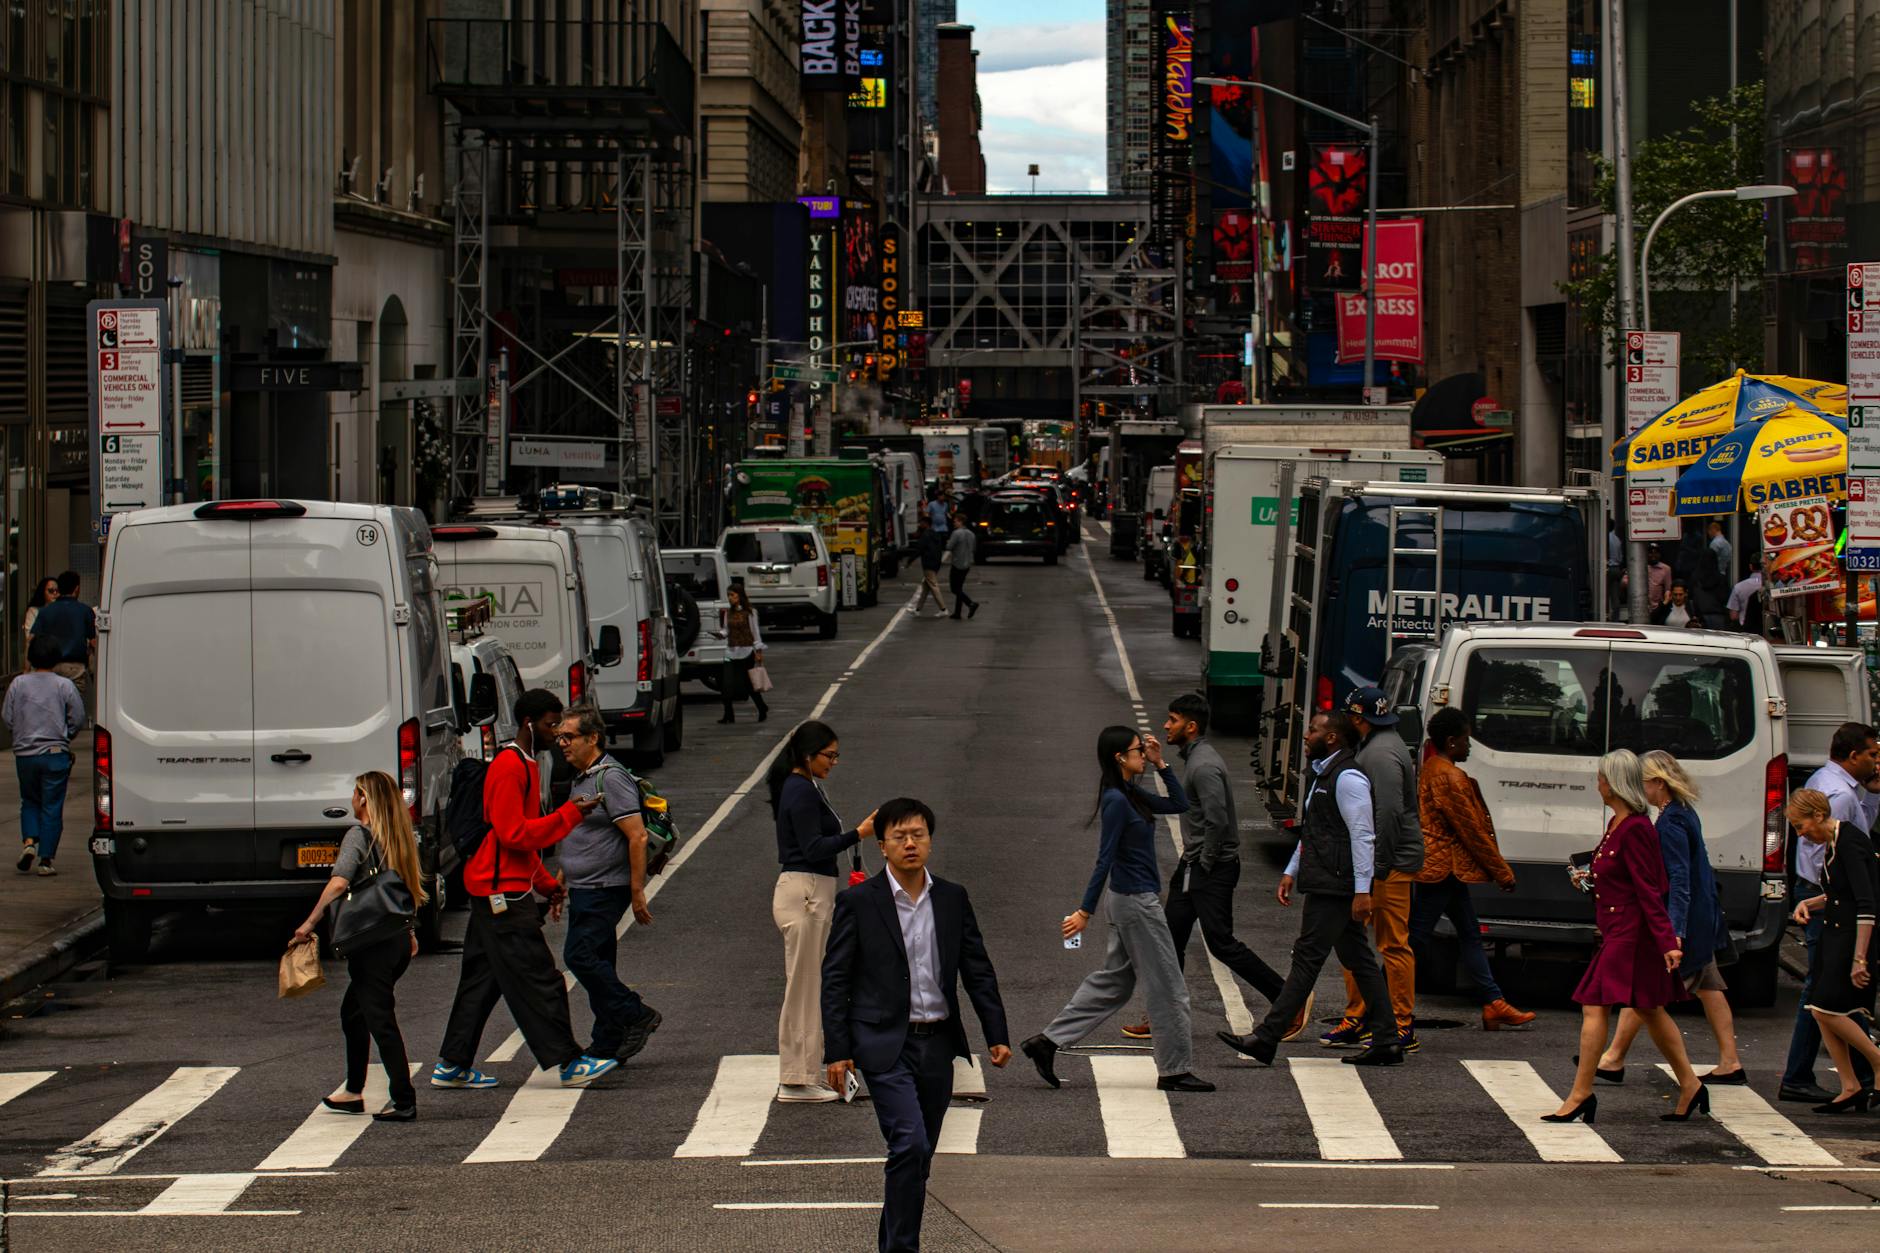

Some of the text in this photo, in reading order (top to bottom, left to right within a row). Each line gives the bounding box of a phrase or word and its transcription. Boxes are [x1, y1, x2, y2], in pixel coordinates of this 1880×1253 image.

[801, 0, 838, 74] BACK
[844, 0, 860, 75] BACK
[1166, 16, 1193, 140] Aladdin
[809, 235, 823, 309] YARD
[1345, 298, 1416, 316] EXRESS
[1852, 314, 1860, 331] 3
[105, 353, 115, 370] 3
[104, 375, 148, 383] COMMERCIAL
[261, 368, 310, 385] FIVE
[1630, 368, 1639, 382] 3
[1851, 408, 1860, 426] 6
[106, 437, 117, 452] 6
[519, 446, 549, 456] LUMA
[1760, 432, 1833, 458] SABRETT
[1774, 501, 1798, 510] CHEESE
[1799, 498, 1825, 506] PRETZEL
[360, 529, 375, 541] T-9
[845, 562, 853, 603] VALET
[1803, 583, 1830, 591] Sausage
[1368, 590, 1551, 621] METRALITE
[513, 620, 540, 628] CORP.
[544, 681, 564, 689] 2204
[1498, 780, 1567, 790] TRANSIT
